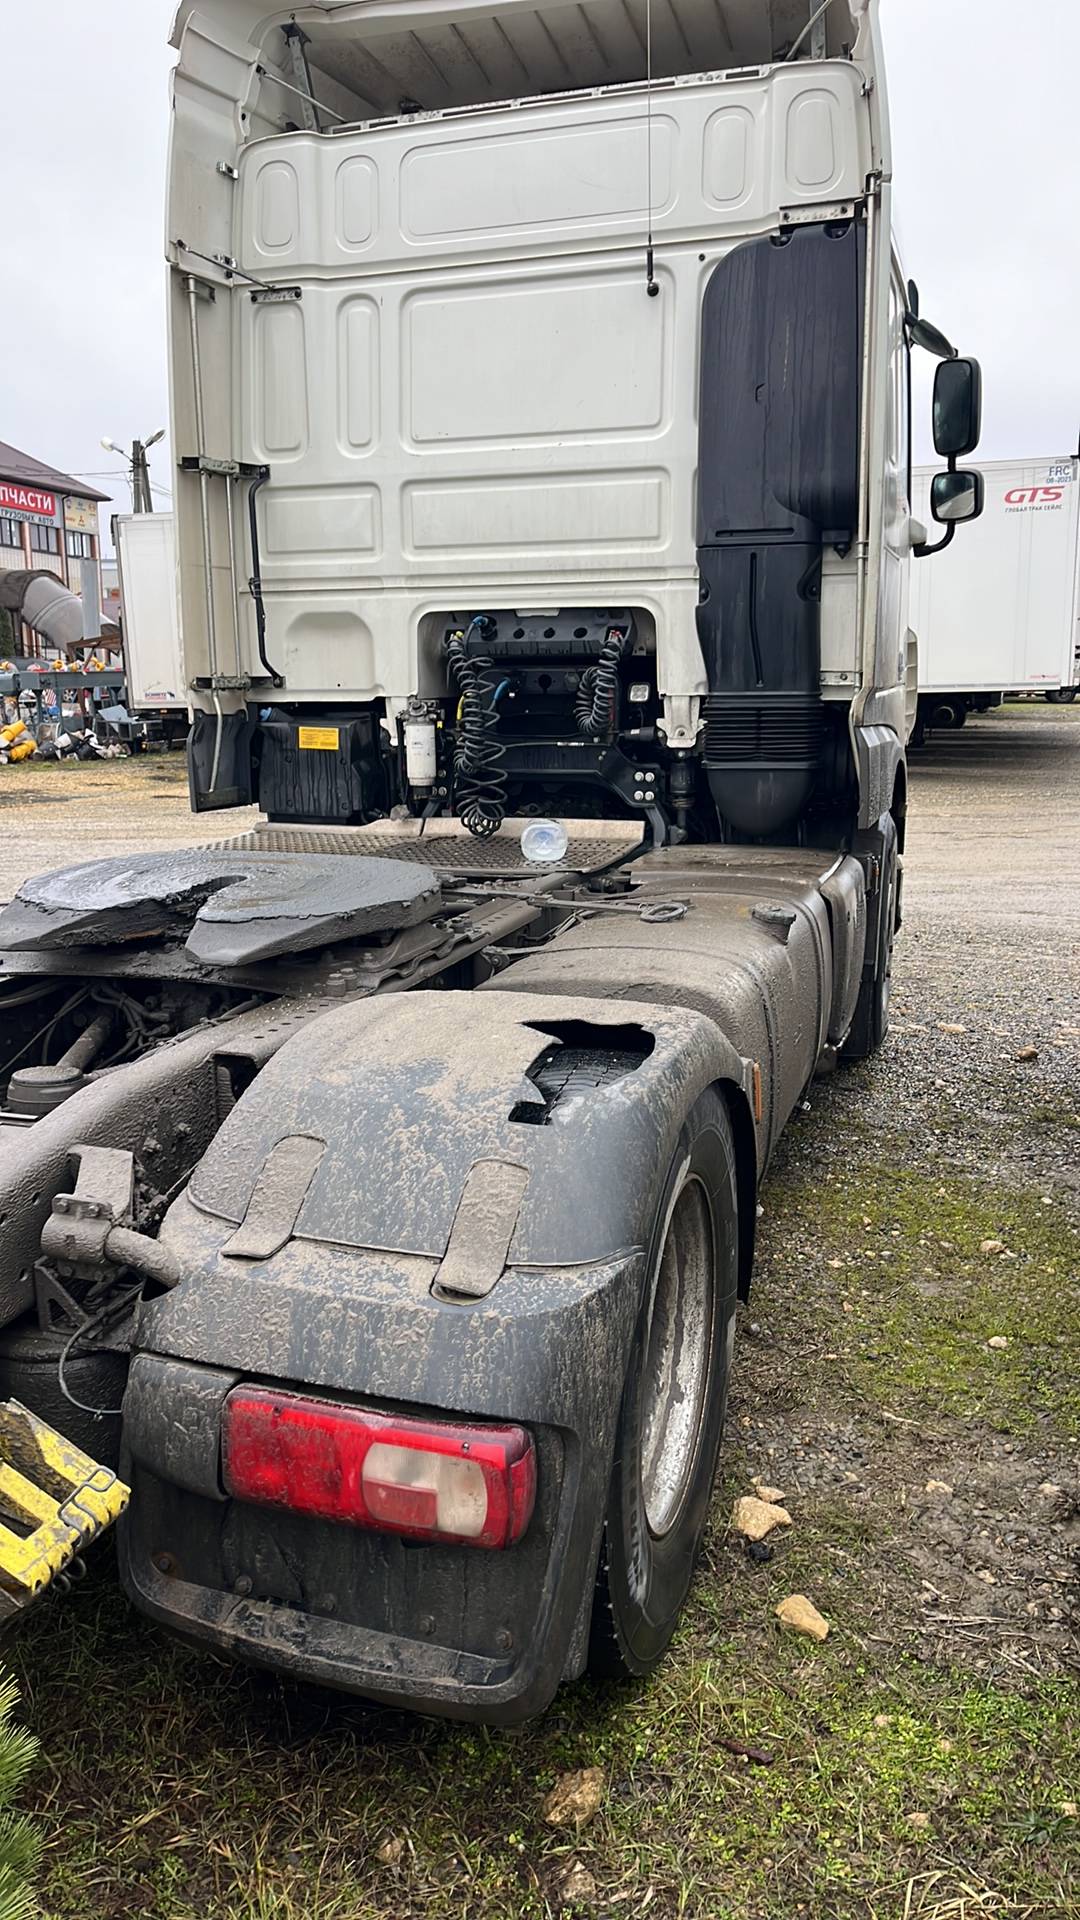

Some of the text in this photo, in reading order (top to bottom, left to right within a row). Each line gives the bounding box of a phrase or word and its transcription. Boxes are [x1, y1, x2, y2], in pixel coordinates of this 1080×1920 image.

[1049, 465, 1070, 476] FRC
[0, 486, 52, 511] ПЧАСТИ
[1004, 487, 1065, 504] GTS
[1, 509, 35, 521] ГРУЗОВЫХ
[38, 516, 54, 525] АВТО
